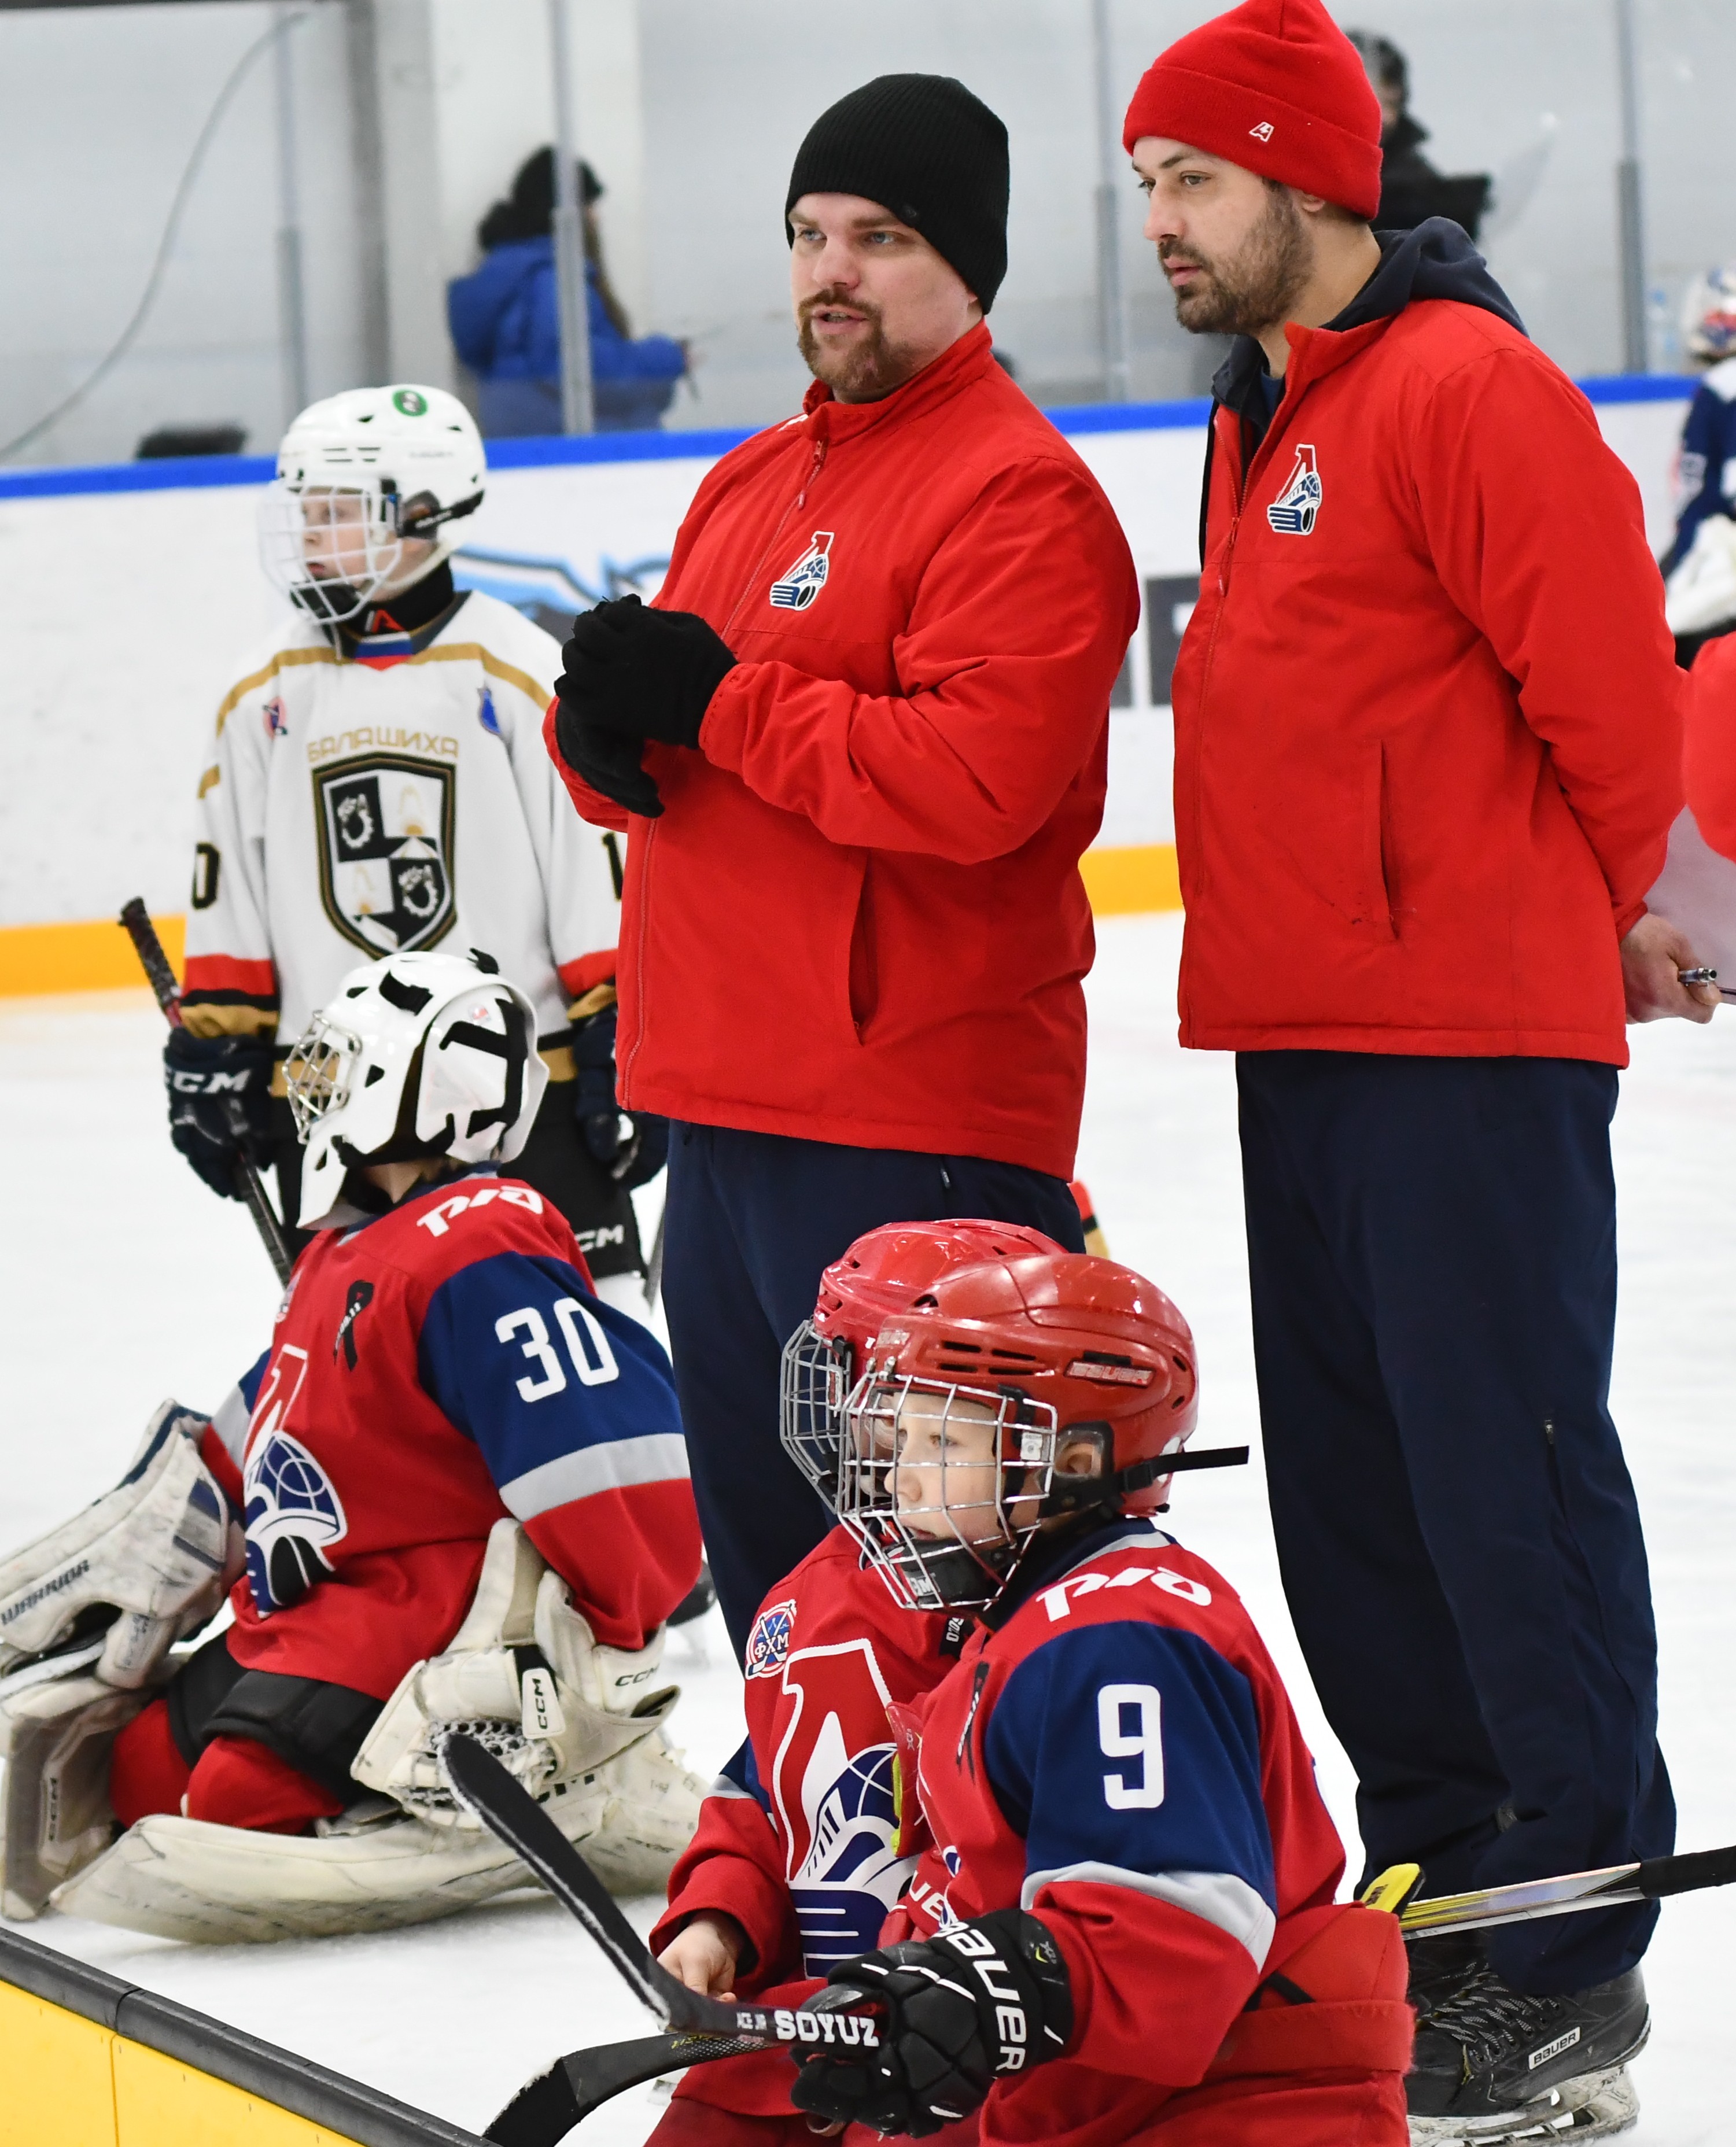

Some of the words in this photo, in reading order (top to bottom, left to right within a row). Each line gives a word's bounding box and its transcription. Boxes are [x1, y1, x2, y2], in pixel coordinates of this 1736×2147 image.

[574, 1224, 624, 1253] CM
[495, 1297, 619, 1403] 30
[754, 1632, 789, 1659] ФХМ
[532, 1678, 548, 1730] CCM
[1097, 1684, 1164, 1810] 9
[930, 1921, 1027, 2071] BAUER
[774, 2009, 879, 2047] SOYUZ
[1534, 2032, 1576, 2065] BAUER
